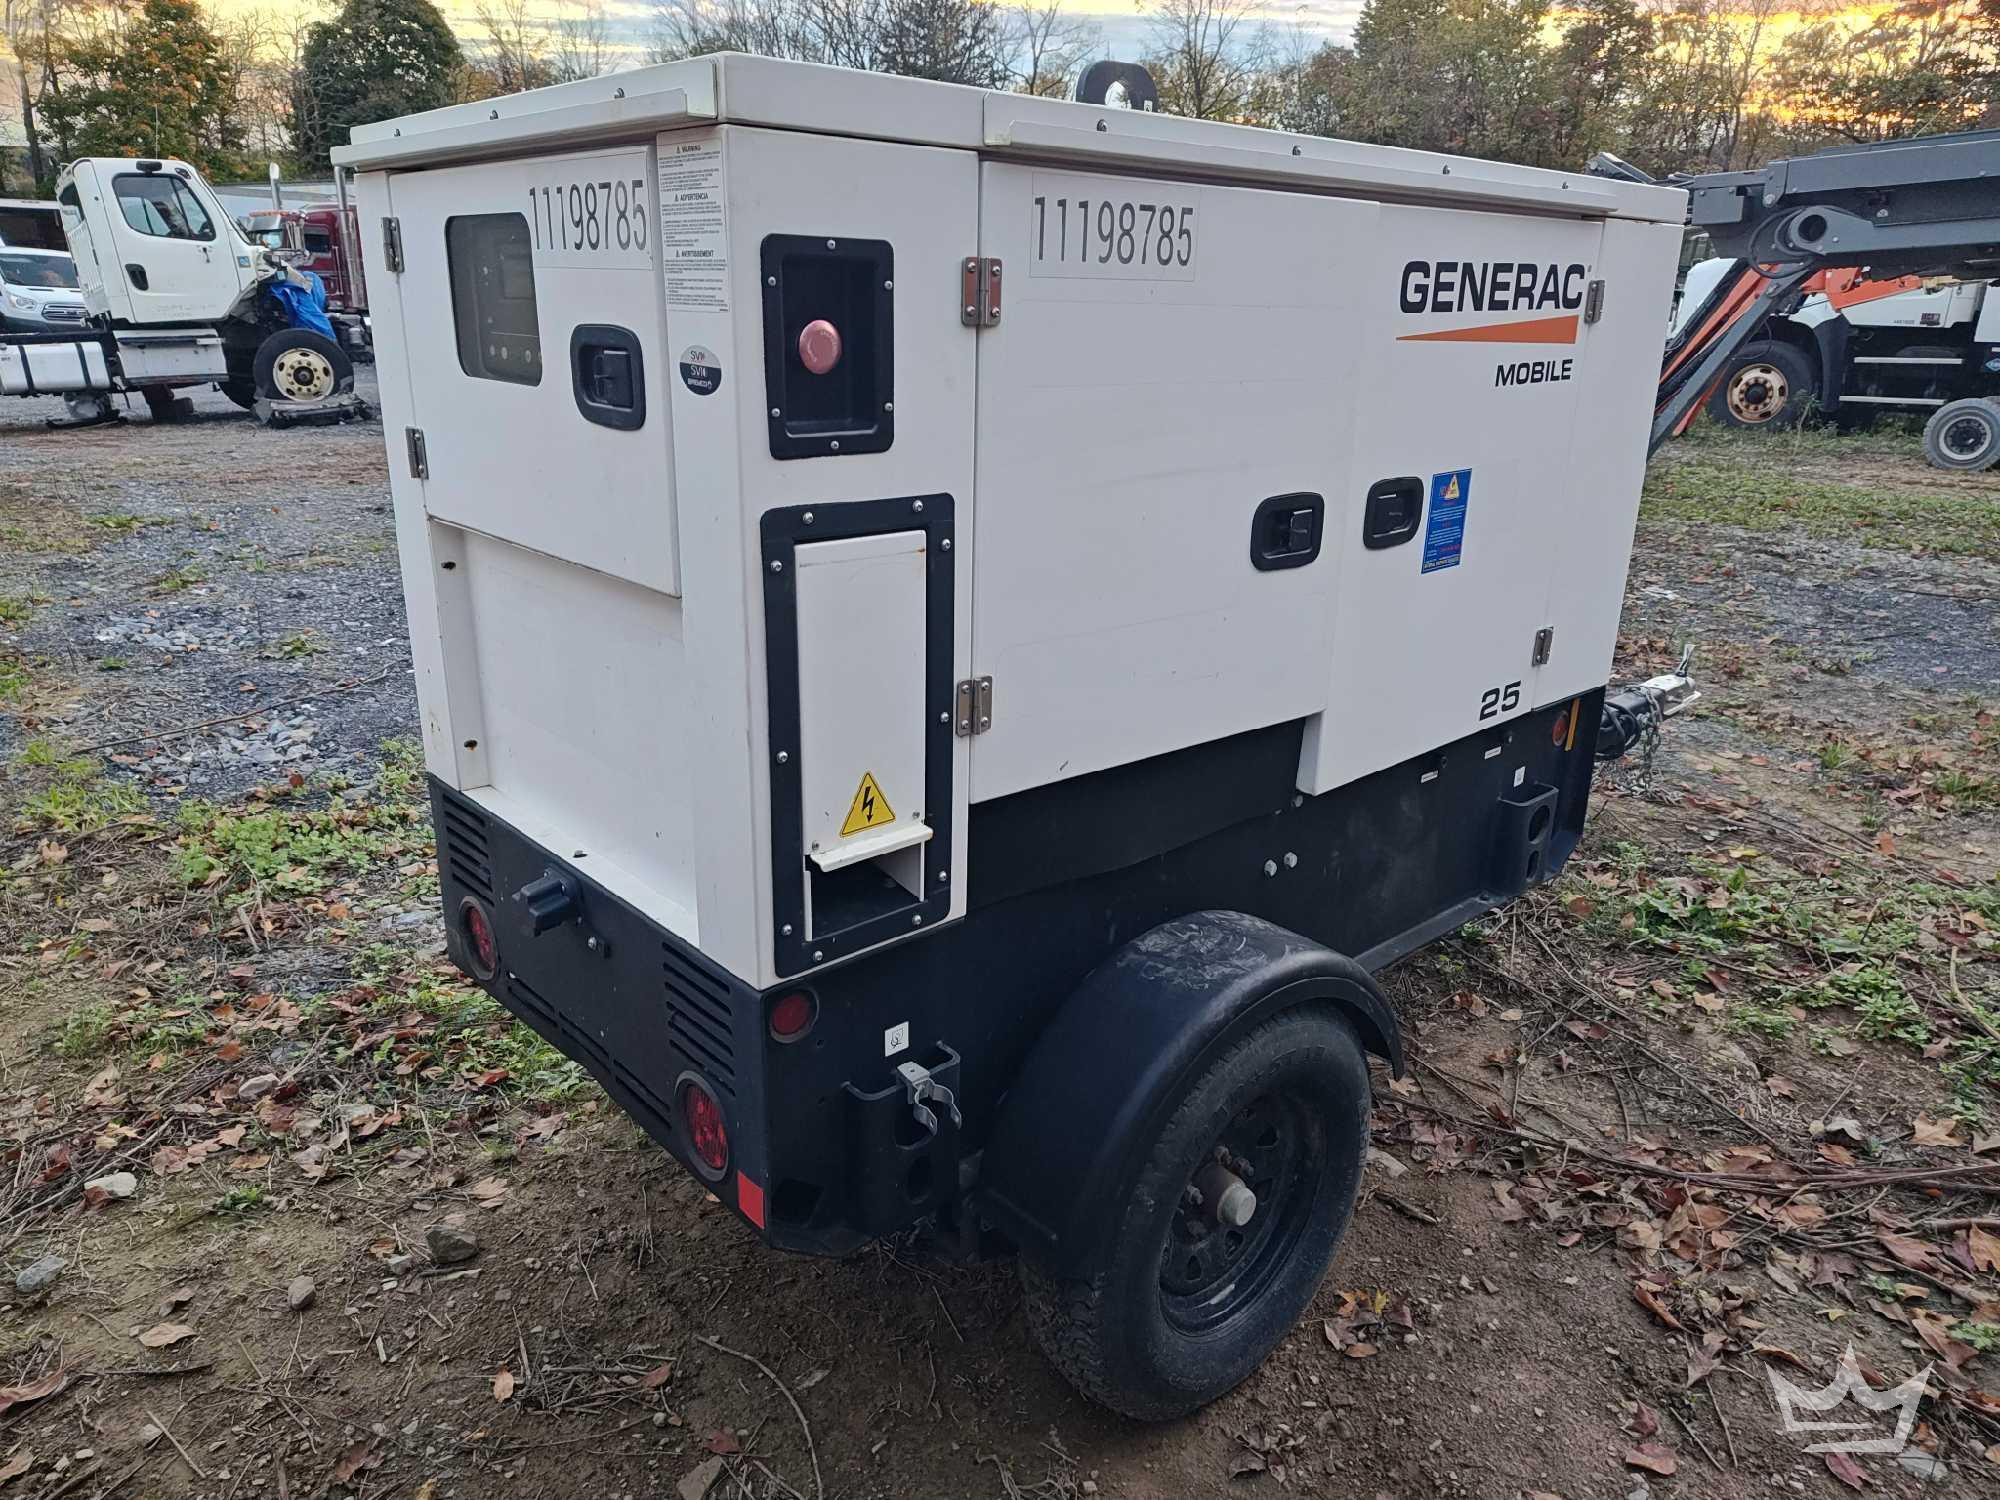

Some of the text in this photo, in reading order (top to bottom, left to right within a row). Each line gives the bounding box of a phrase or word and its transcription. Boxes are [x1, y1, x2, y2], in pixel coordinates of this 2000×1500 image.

[529, 179, 647, 250] 11198785
[1034, 196, 1194, 266] 11198785
[1400, 260, 1585, 314] GENERAC
[1495, 358, 1573, 387] MOBILE
[1479, 680, 1521, 721] 25
